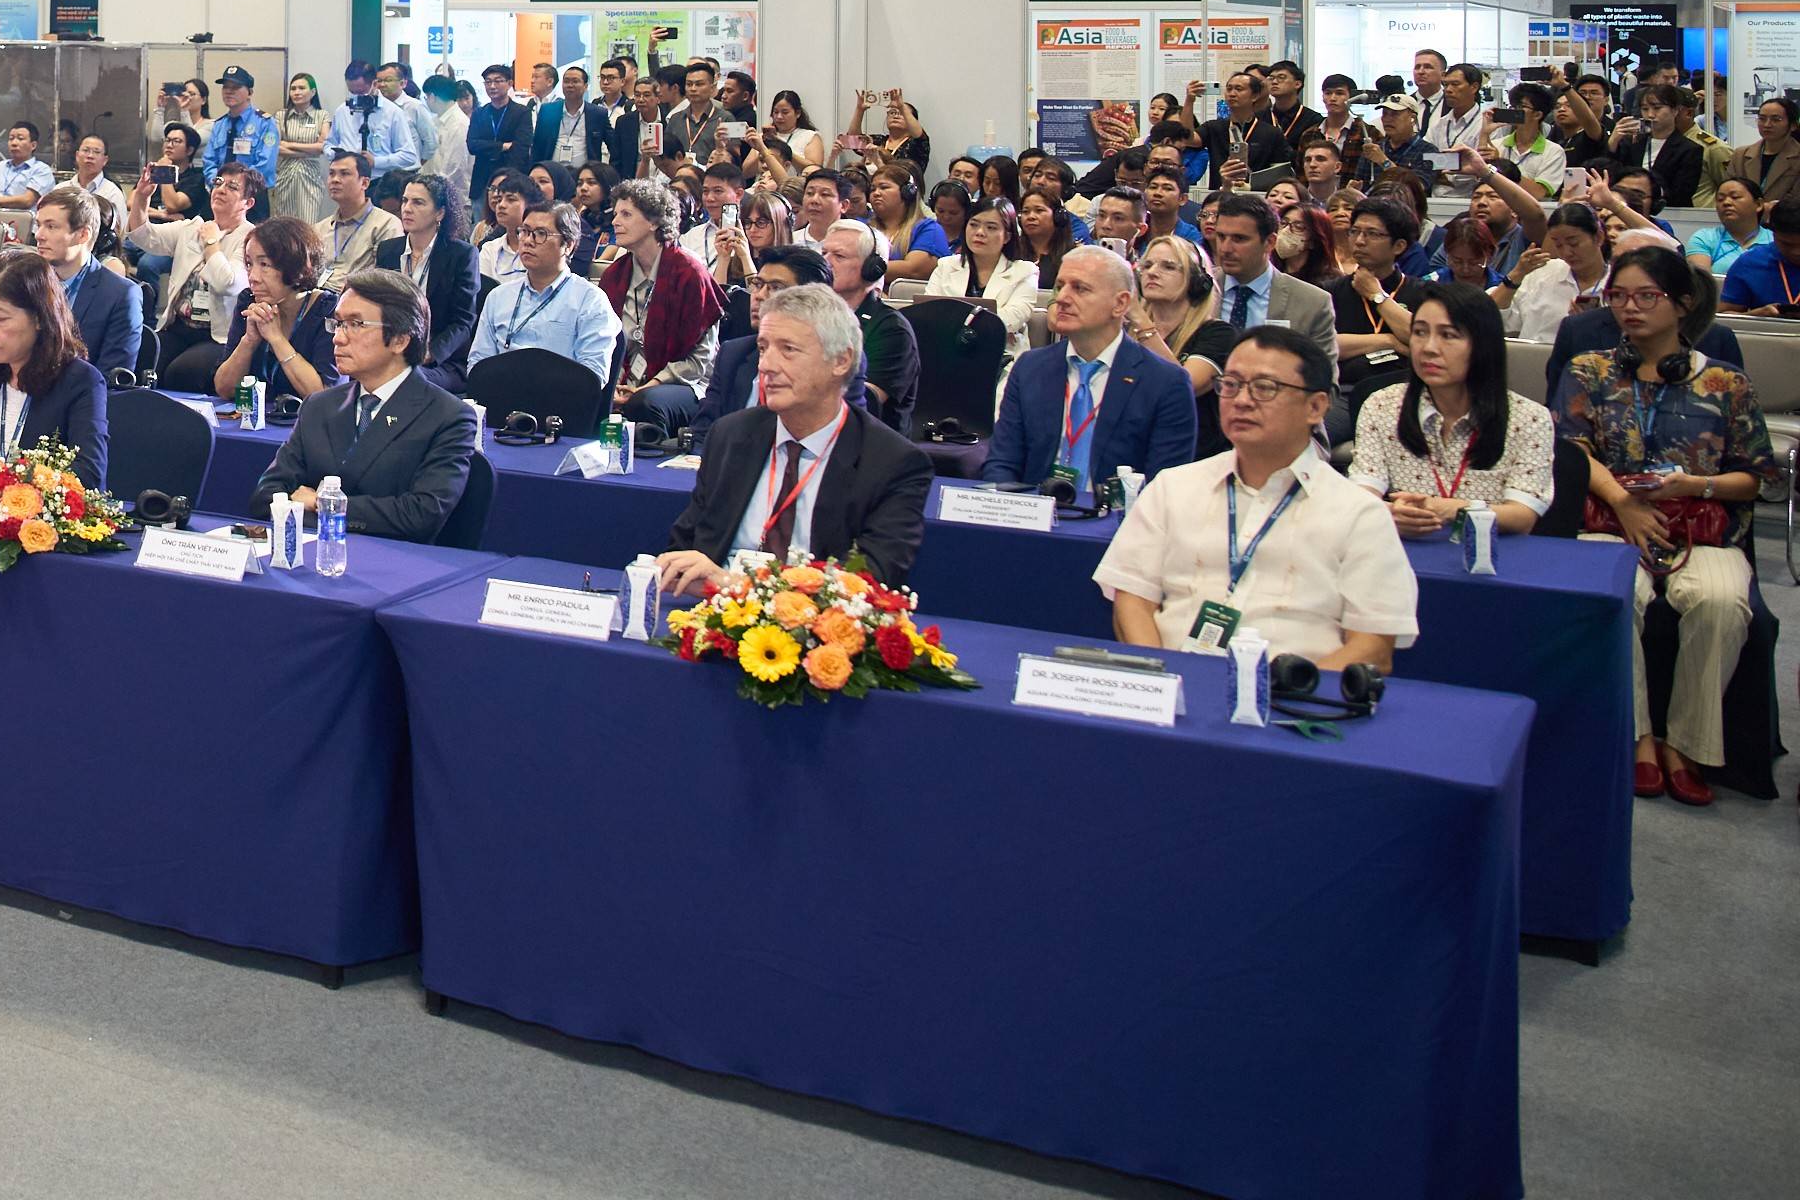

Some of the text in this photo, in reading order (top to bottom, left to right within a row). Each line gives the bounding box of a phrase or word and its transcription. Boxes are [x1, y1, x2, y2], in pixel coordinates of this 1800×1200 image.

[1232, 27, 1248, 35] FOOD
[1388, 20, 1436, 31] Piovan
[1058, 28, 1103, 45] Asia
[1105, 27, 1120, 36] FOOD
[1105, 35, 1138, 44] BEVERAGES
[1232, 35, 1266, 44] BEVERAGES
[971, 494, 1001, 504] MICHELE
[1003, 498, 1039, 508] D'ERCOLE
[973, 508, 999, 516] CHAMBER
[1008, 512, 1039, 521] COMMERCE
[161, 538, 177, 547] ÔNG
[212, 547, 229, 555] ANH
[507, 593, 590, 611] MR. ENRICO PADULA
[510, 610, 535, 620] GENERAL
[544, 615, 560, 623] ITALY
[520, 604, 572, 618] CONSUL GENERAL
[1050, 670, 1090, 685] JOSEPH
[1092, 677, 1119, 688] ROSS
[1121, 681, 1164, 695] JOCSON
[1050, 691, 1091, 704] PACKAGING
[1093, 697, 1142, 711] FEDERATION
